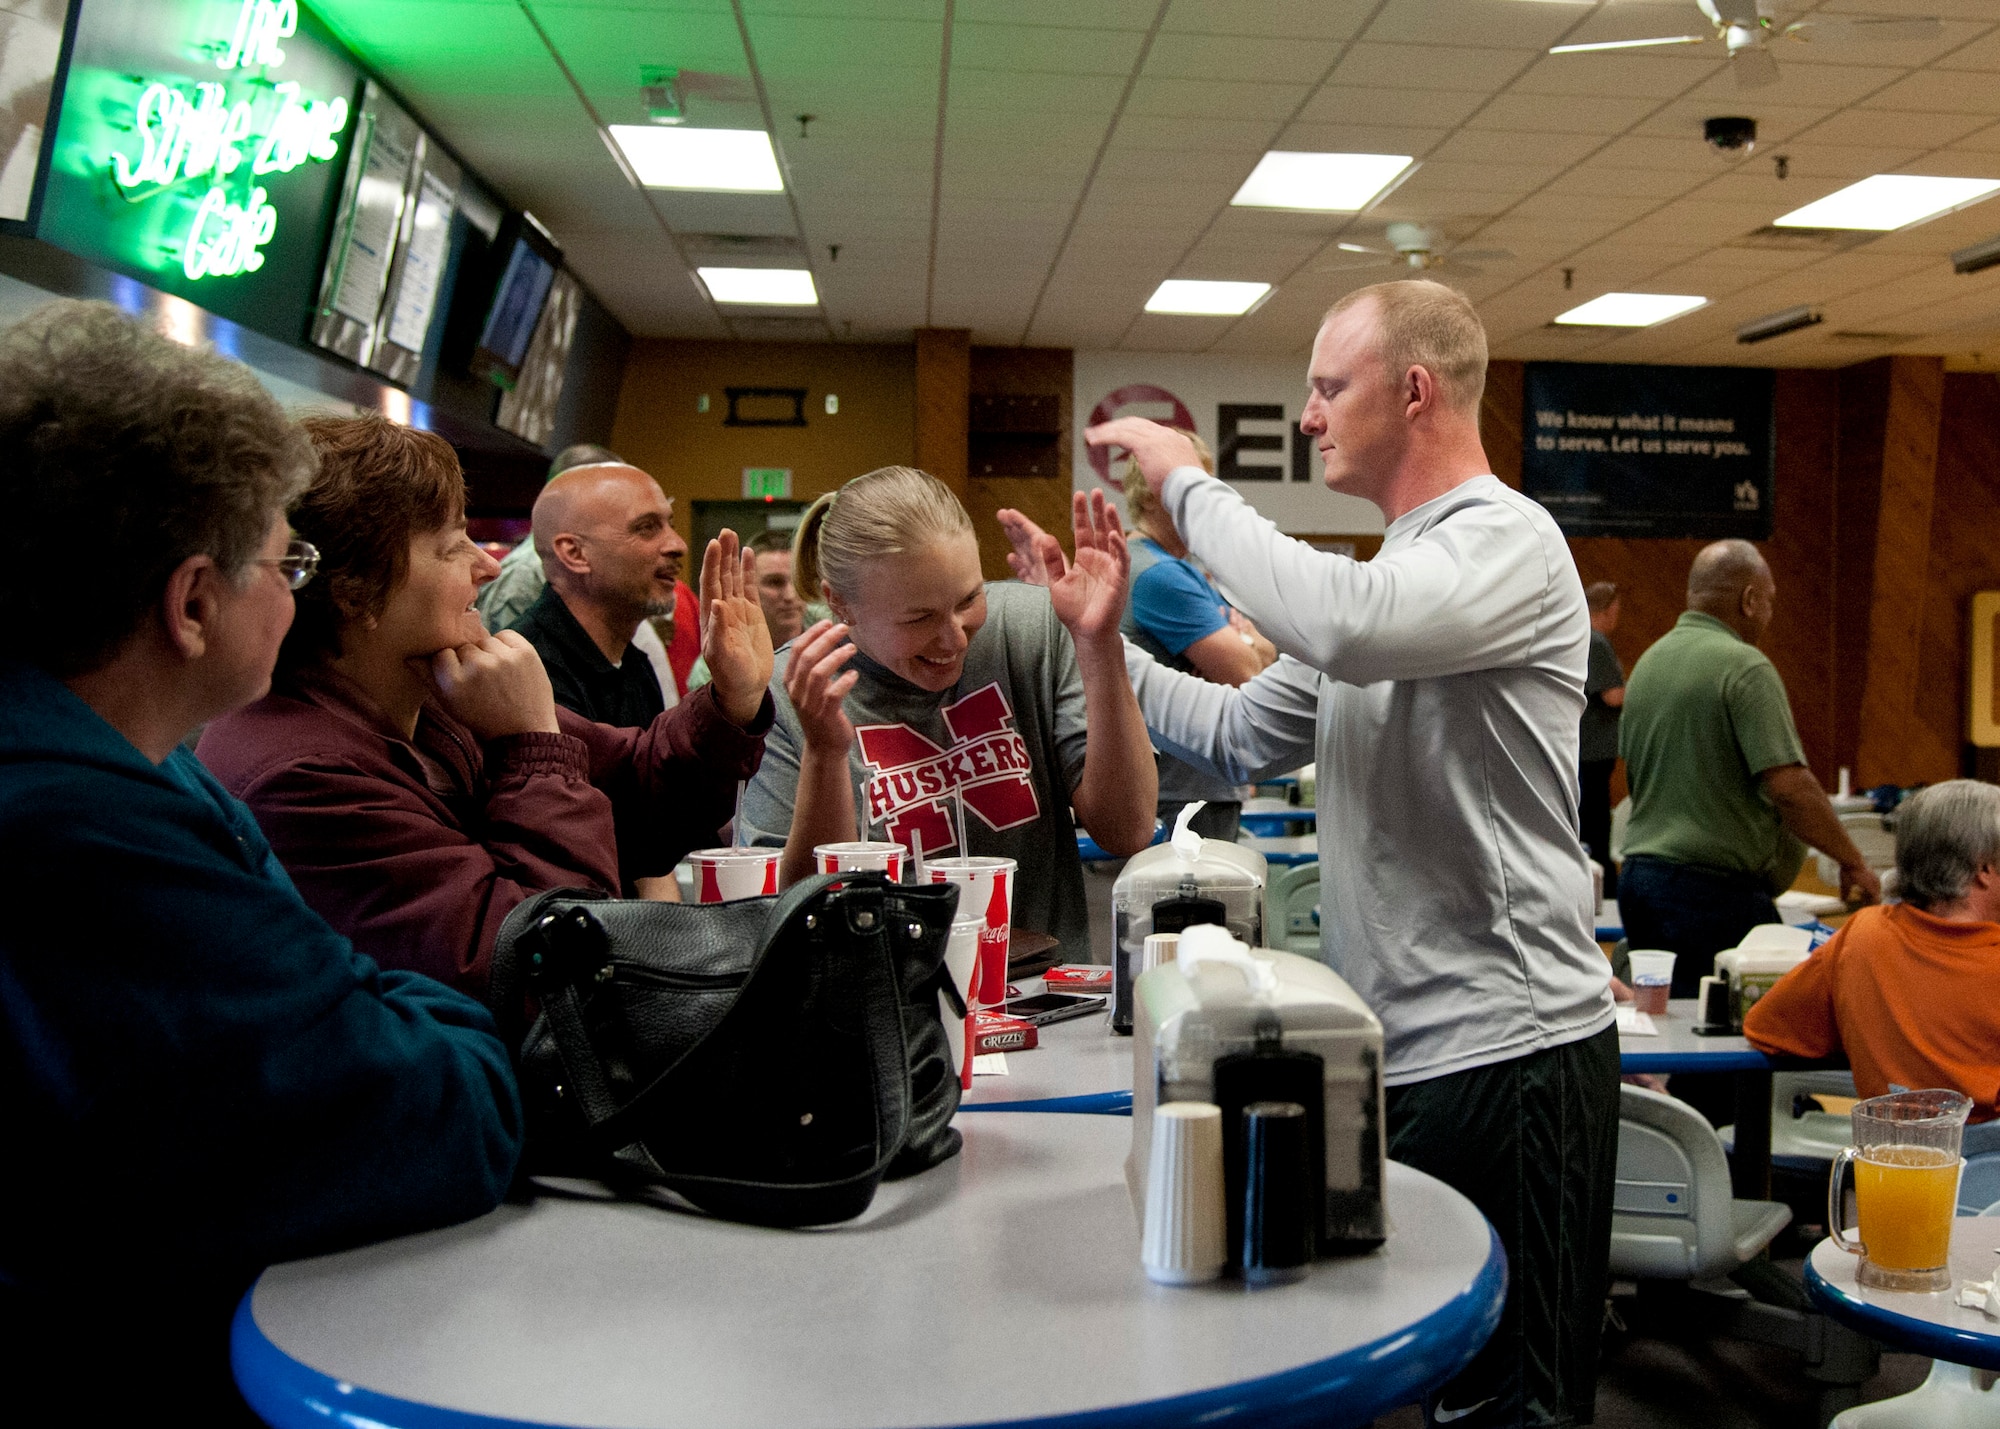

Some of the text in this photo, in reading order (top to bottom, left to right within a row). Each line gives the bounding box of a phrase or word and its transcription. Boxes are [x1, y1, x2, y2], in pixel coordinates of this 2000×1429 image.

[1536, 410, 1735, 432] We know what it means
[1536, 435, 1750, 458] to serve. Let us serve you.
[868, 735, 1032, 820] HUSKERS
[982, 1031, 1025, 1048] GRIZZLY
